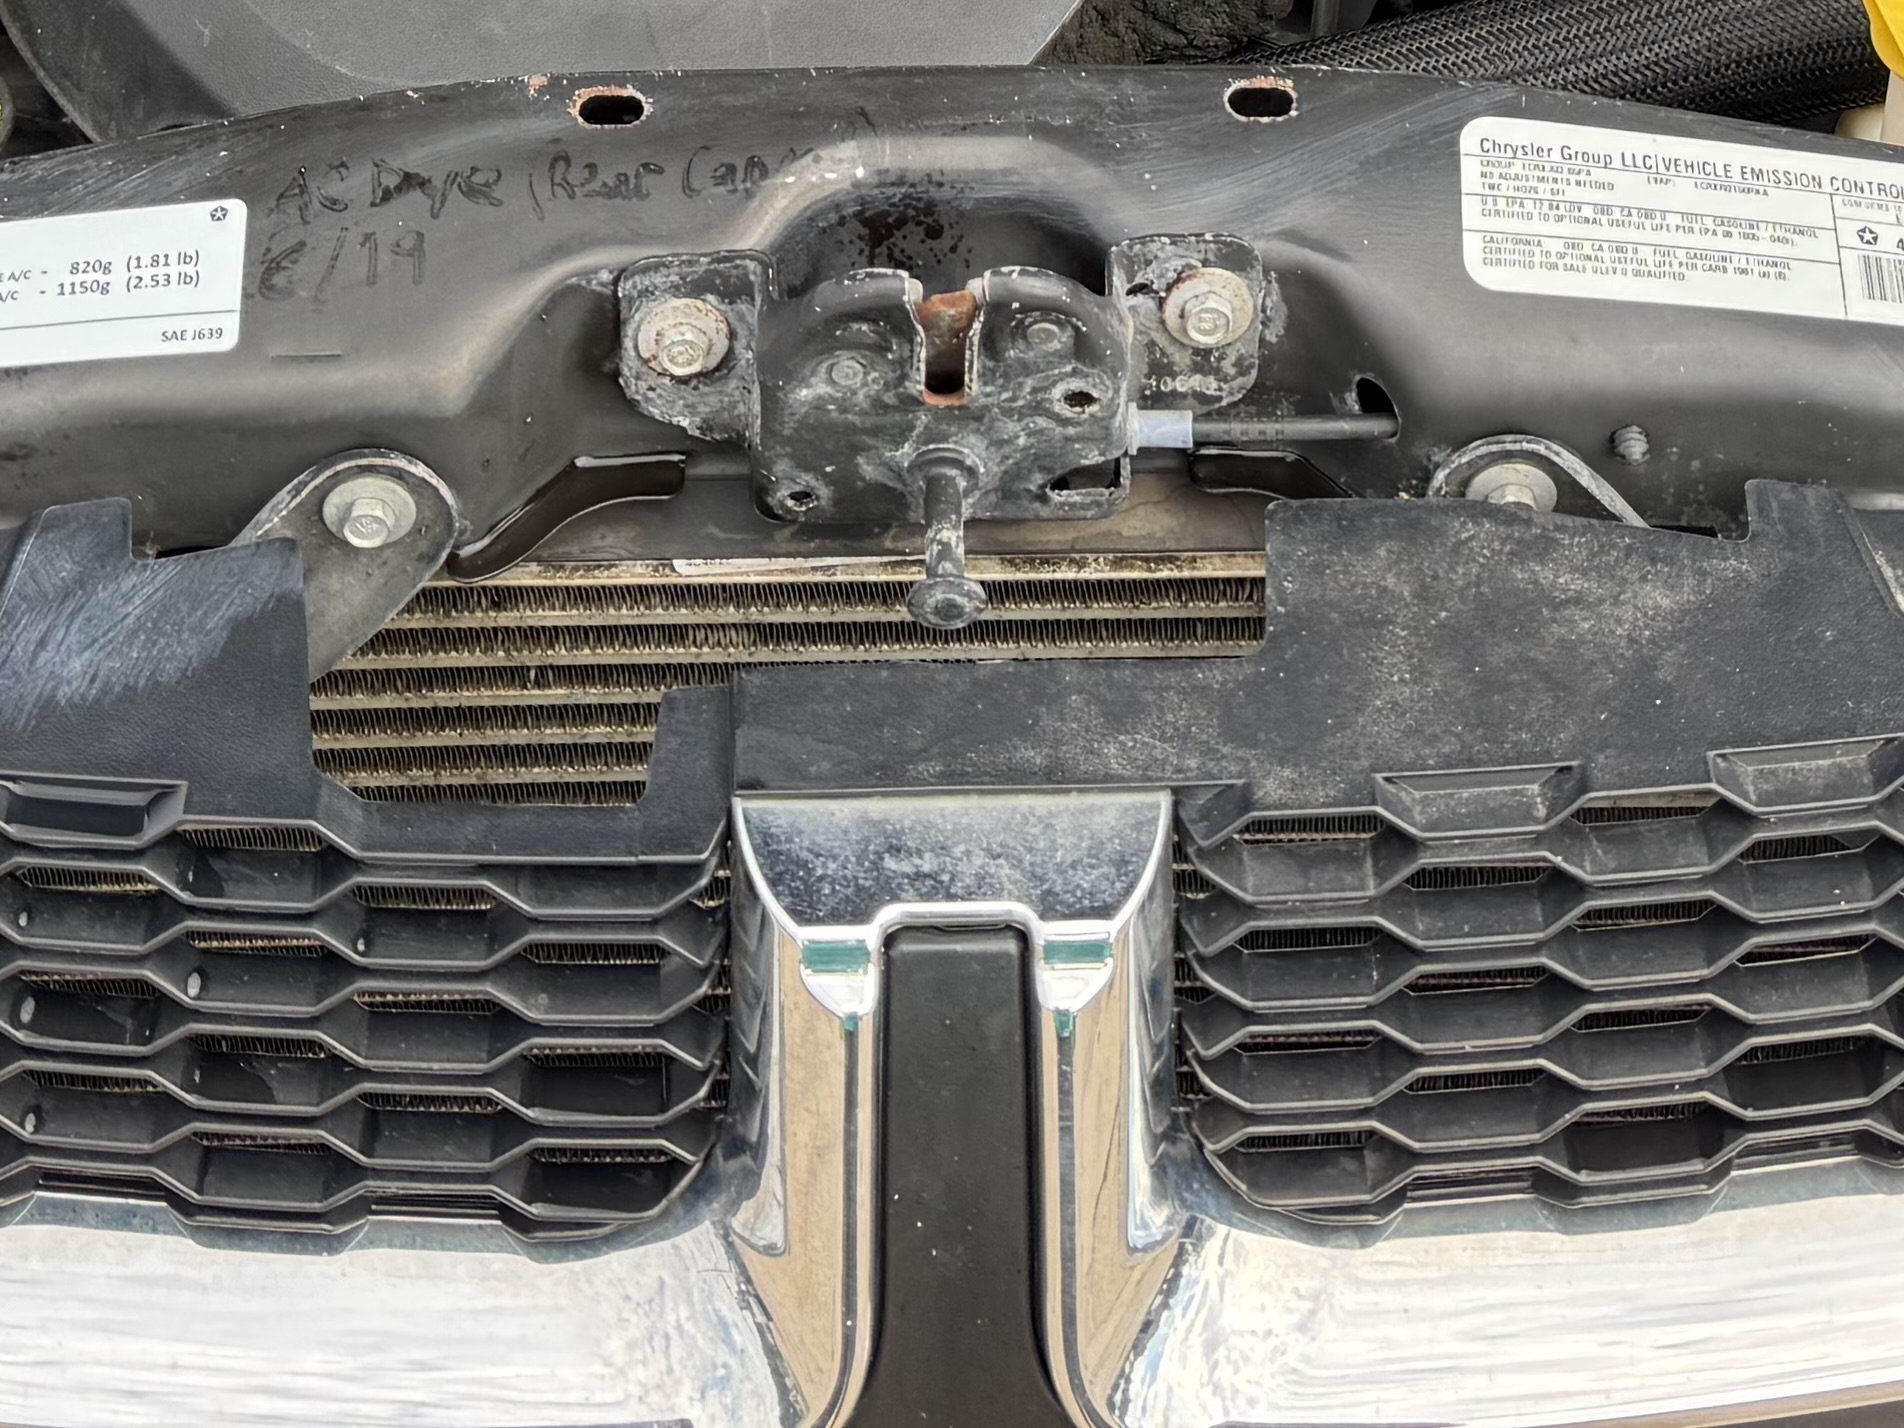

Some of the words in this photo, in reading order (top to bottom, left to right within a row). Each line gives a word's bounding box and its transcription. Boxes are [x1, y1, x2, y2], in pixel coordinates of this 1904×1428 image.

[1479, 136, 1555, 162] Chrysler
[1559, 145, 1613, 169] Group
[1738, 165, 1824, 190] EMISSION
[1538, 211, 1549, 222] TO
[1539, 249, 1551, 259] TO
[7, 268, 33, 282] A/C
[69, 260, 113, 277] 820g
[125, 255, 171, 273] (1.81
[177, 249, 200, 268] lb)
[56, 280, 111, 297] 1150g
[125, 274, 171, 294] (2.53
[177, 270, 200, 288] lb)
[161, 329, 188, 343] SAE
[191, 327, 223, 341] J639
